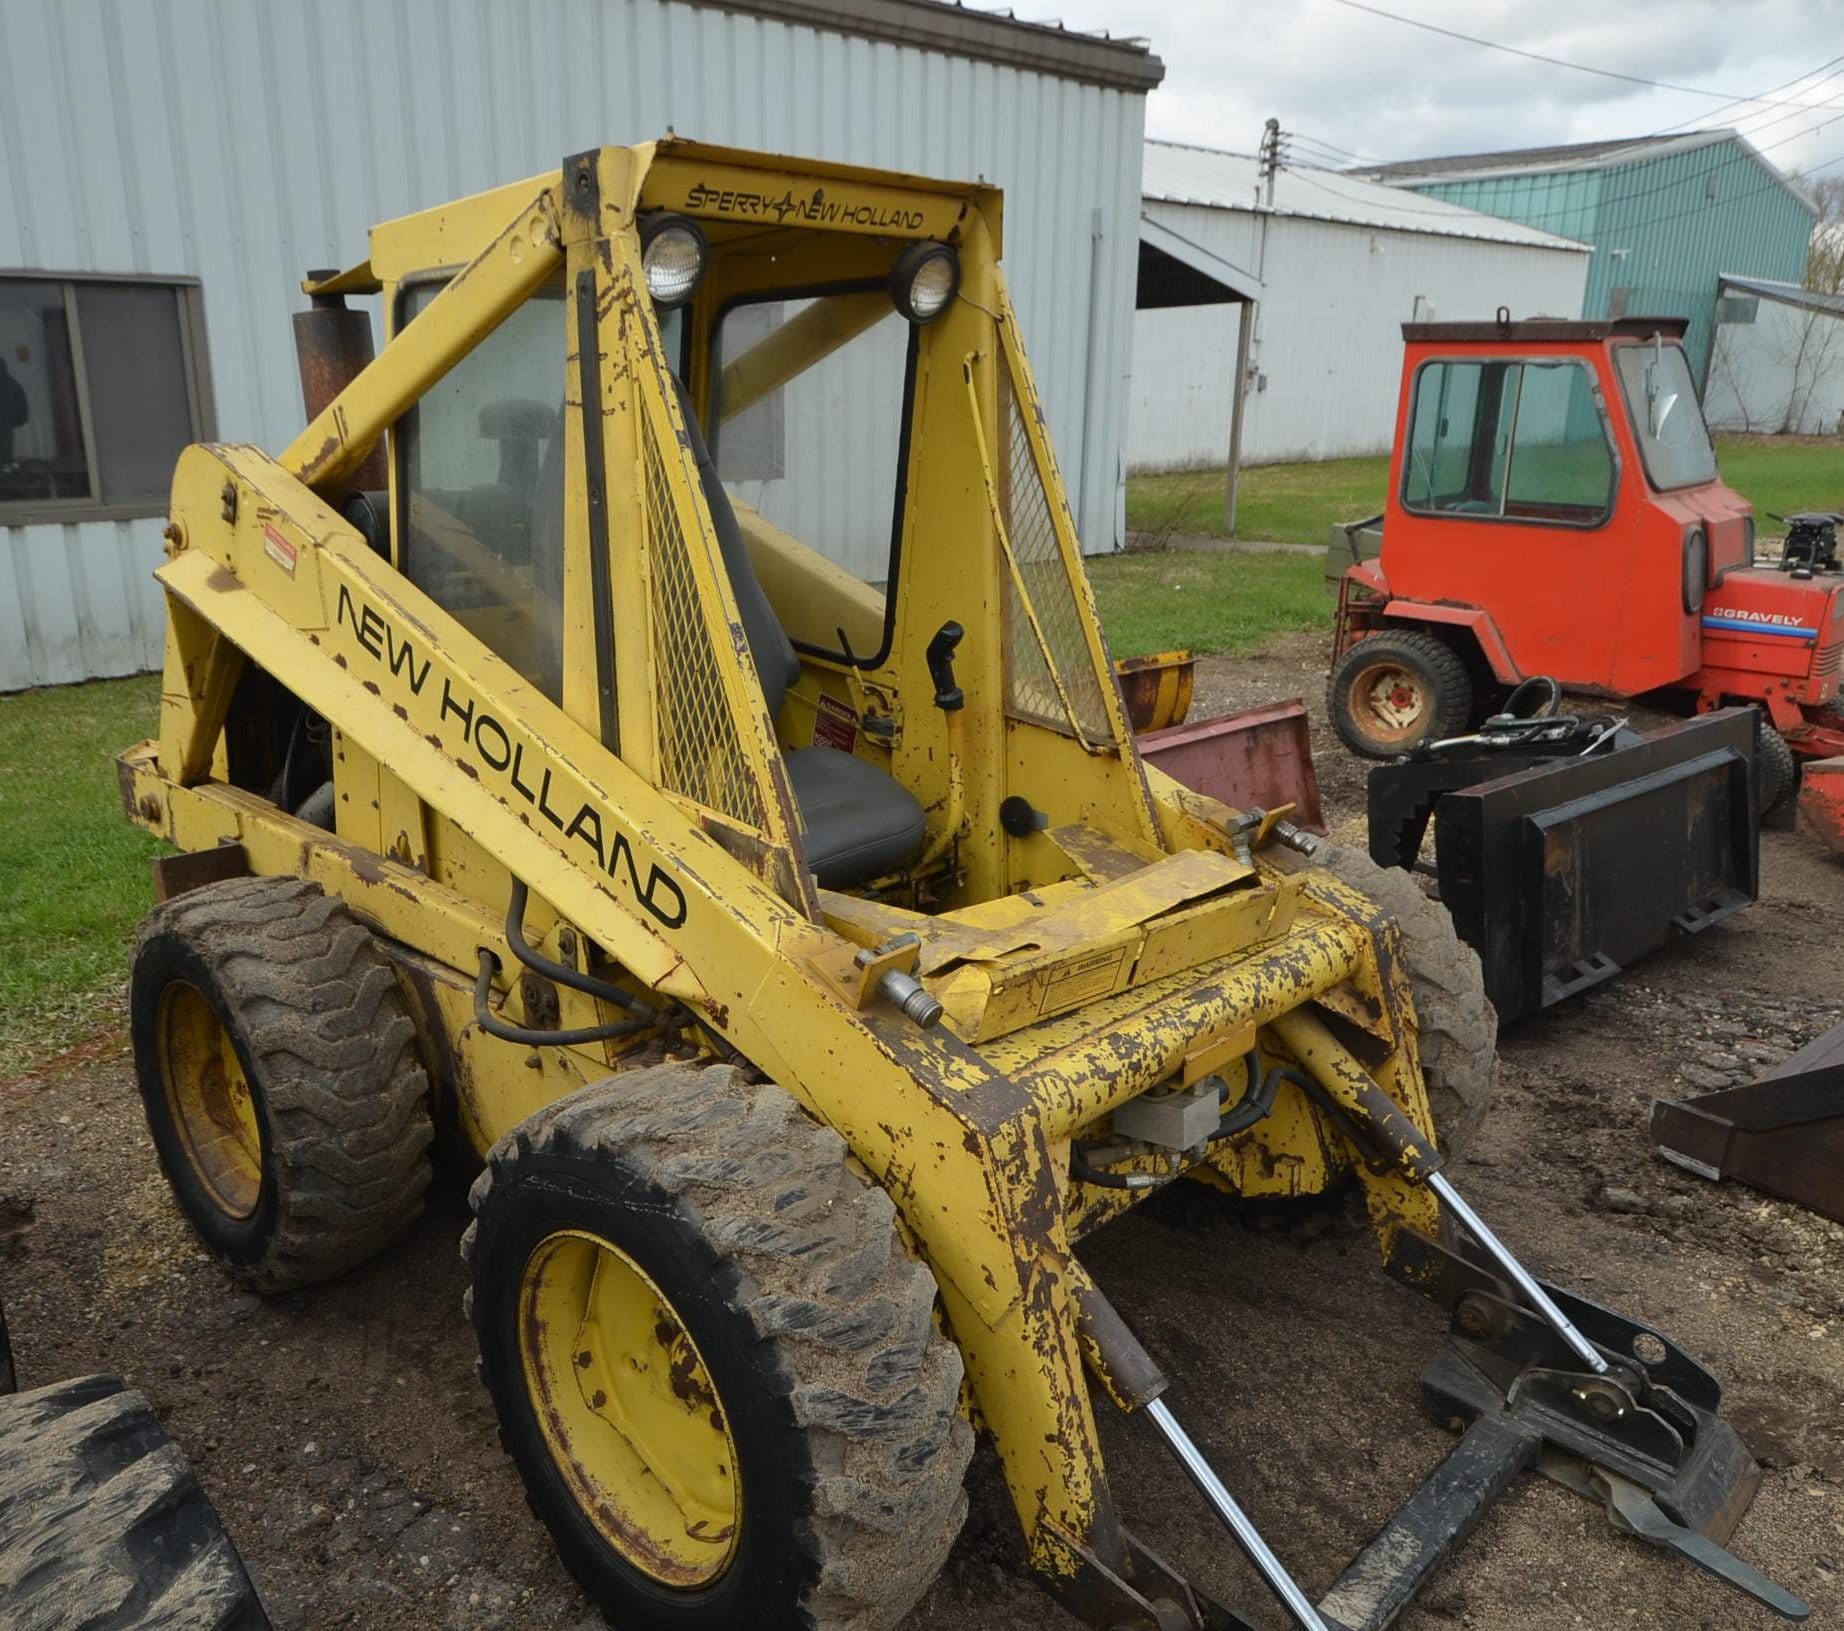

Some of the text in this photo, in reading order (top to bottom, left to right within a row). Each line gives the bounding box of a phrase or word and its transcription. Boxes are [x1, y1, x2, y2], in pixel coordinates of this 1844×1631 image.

[685, 187, 924, 229] SPERRY NEW HOLLAND
[1723, 609, 1803, 626] GRAVELY
[338, 584, 688, 930] NEW HOLLAND
